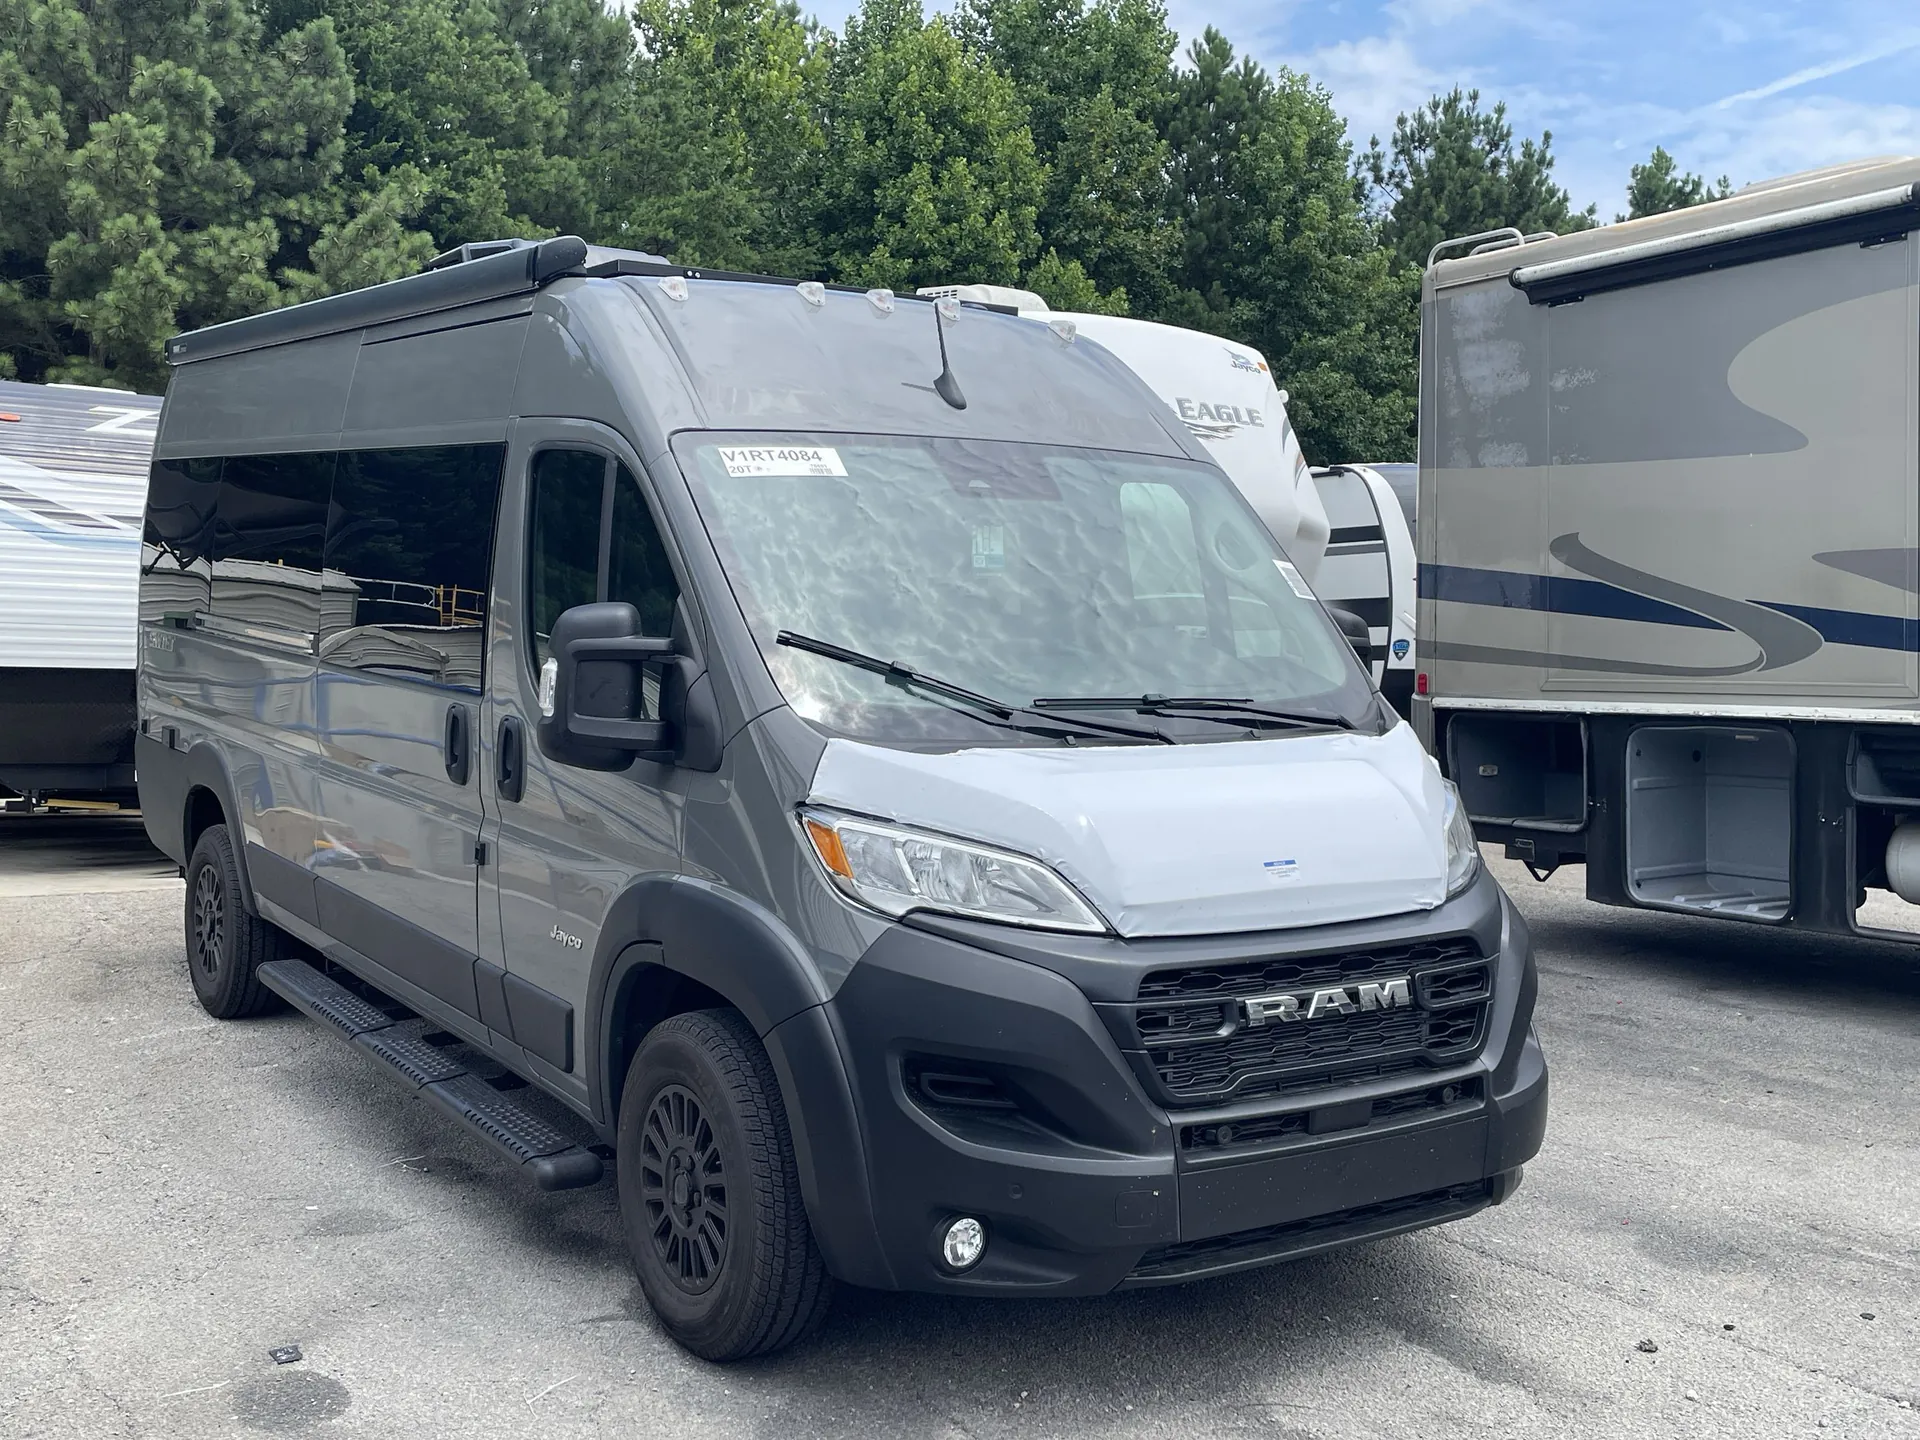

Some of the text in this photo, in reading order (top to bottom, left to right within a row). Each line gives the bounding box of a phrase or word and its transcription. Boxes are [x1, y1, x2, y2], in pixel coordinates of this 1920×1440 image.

[1231, 361, 1261, 374] Jayco
[1175, 397, 1264, 428] EAGLE
[722, 450, 822, 462] V1RT4084
[550, 924, 583, 950] Jayco
[1245, 980, 1411, 1027] RAM
